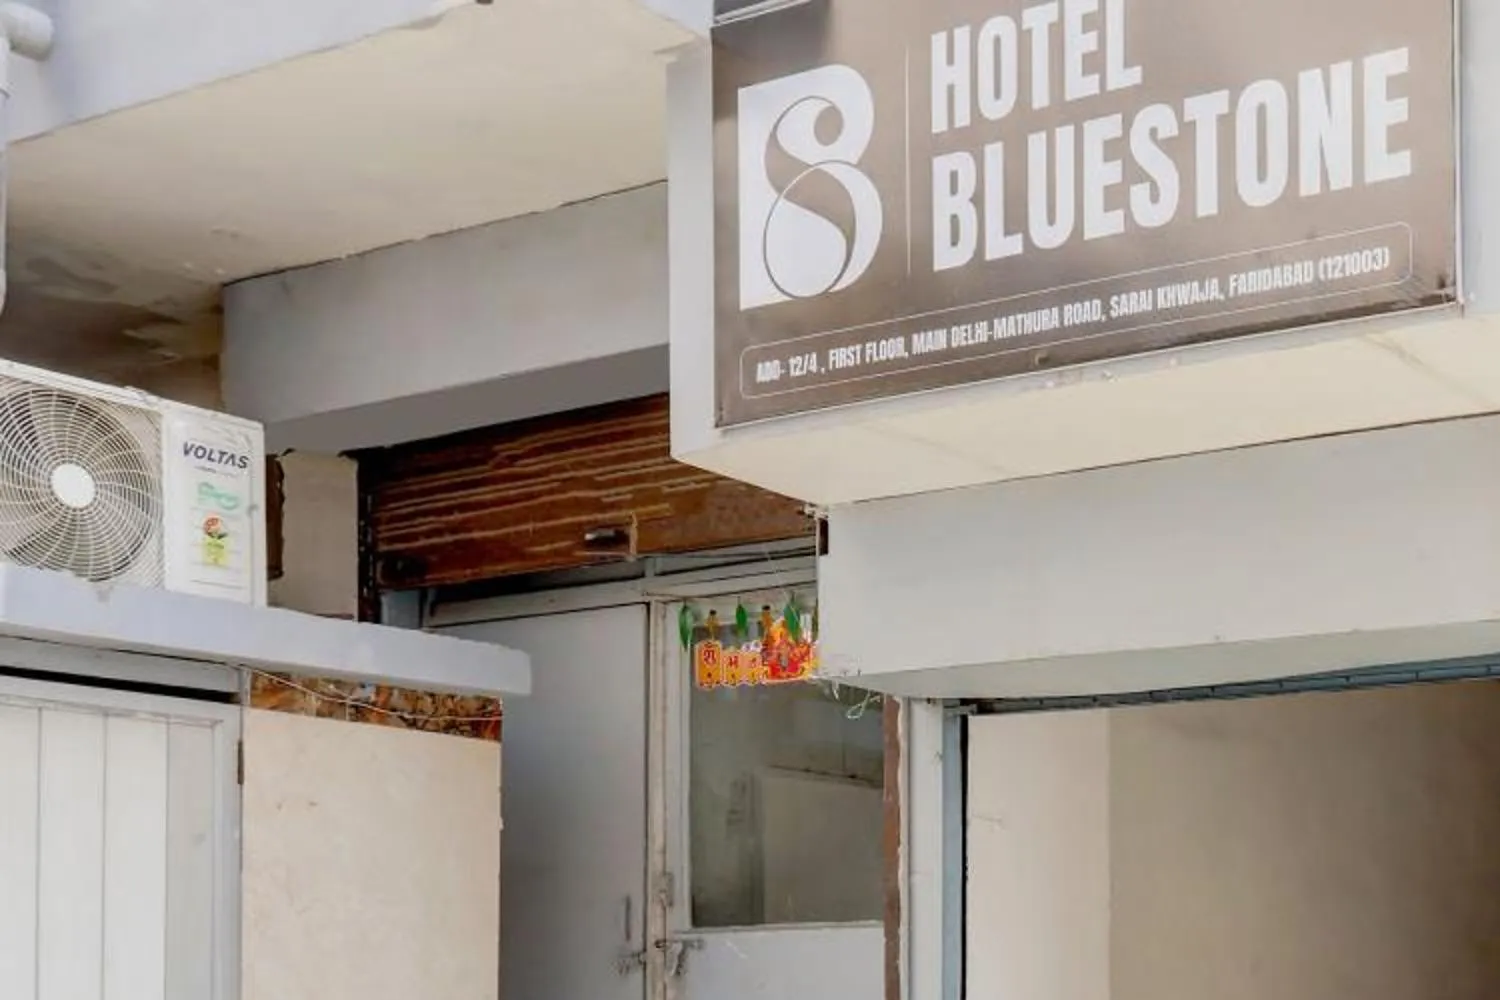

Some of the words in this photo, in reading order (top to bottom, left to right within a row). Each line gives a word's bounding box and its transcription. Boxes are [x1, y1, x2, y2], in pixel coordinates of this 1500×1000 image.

[930, 0, 1143, 134] HOTEL
[931, 47, 1412, 272] BLUESTONE
[828, 342, 863, 370] FIRST
[865, 335, 909, 363] FLOOR,
[911, 328, 948, 356] MAIN
[951, 306, 1061, 347] DELHI-MATHURA
[1063, 298, 1107, 327] ROAD,
[1109, 288, 1153, 319] SARAI
[1156, 277, 1226, 311] KHWAJA,
[1228, 259, 1315, 298] FARIDABAD
[1318, 246, 1390, 282] (121003)
[182, 441, 250, 470] VOLTAS
